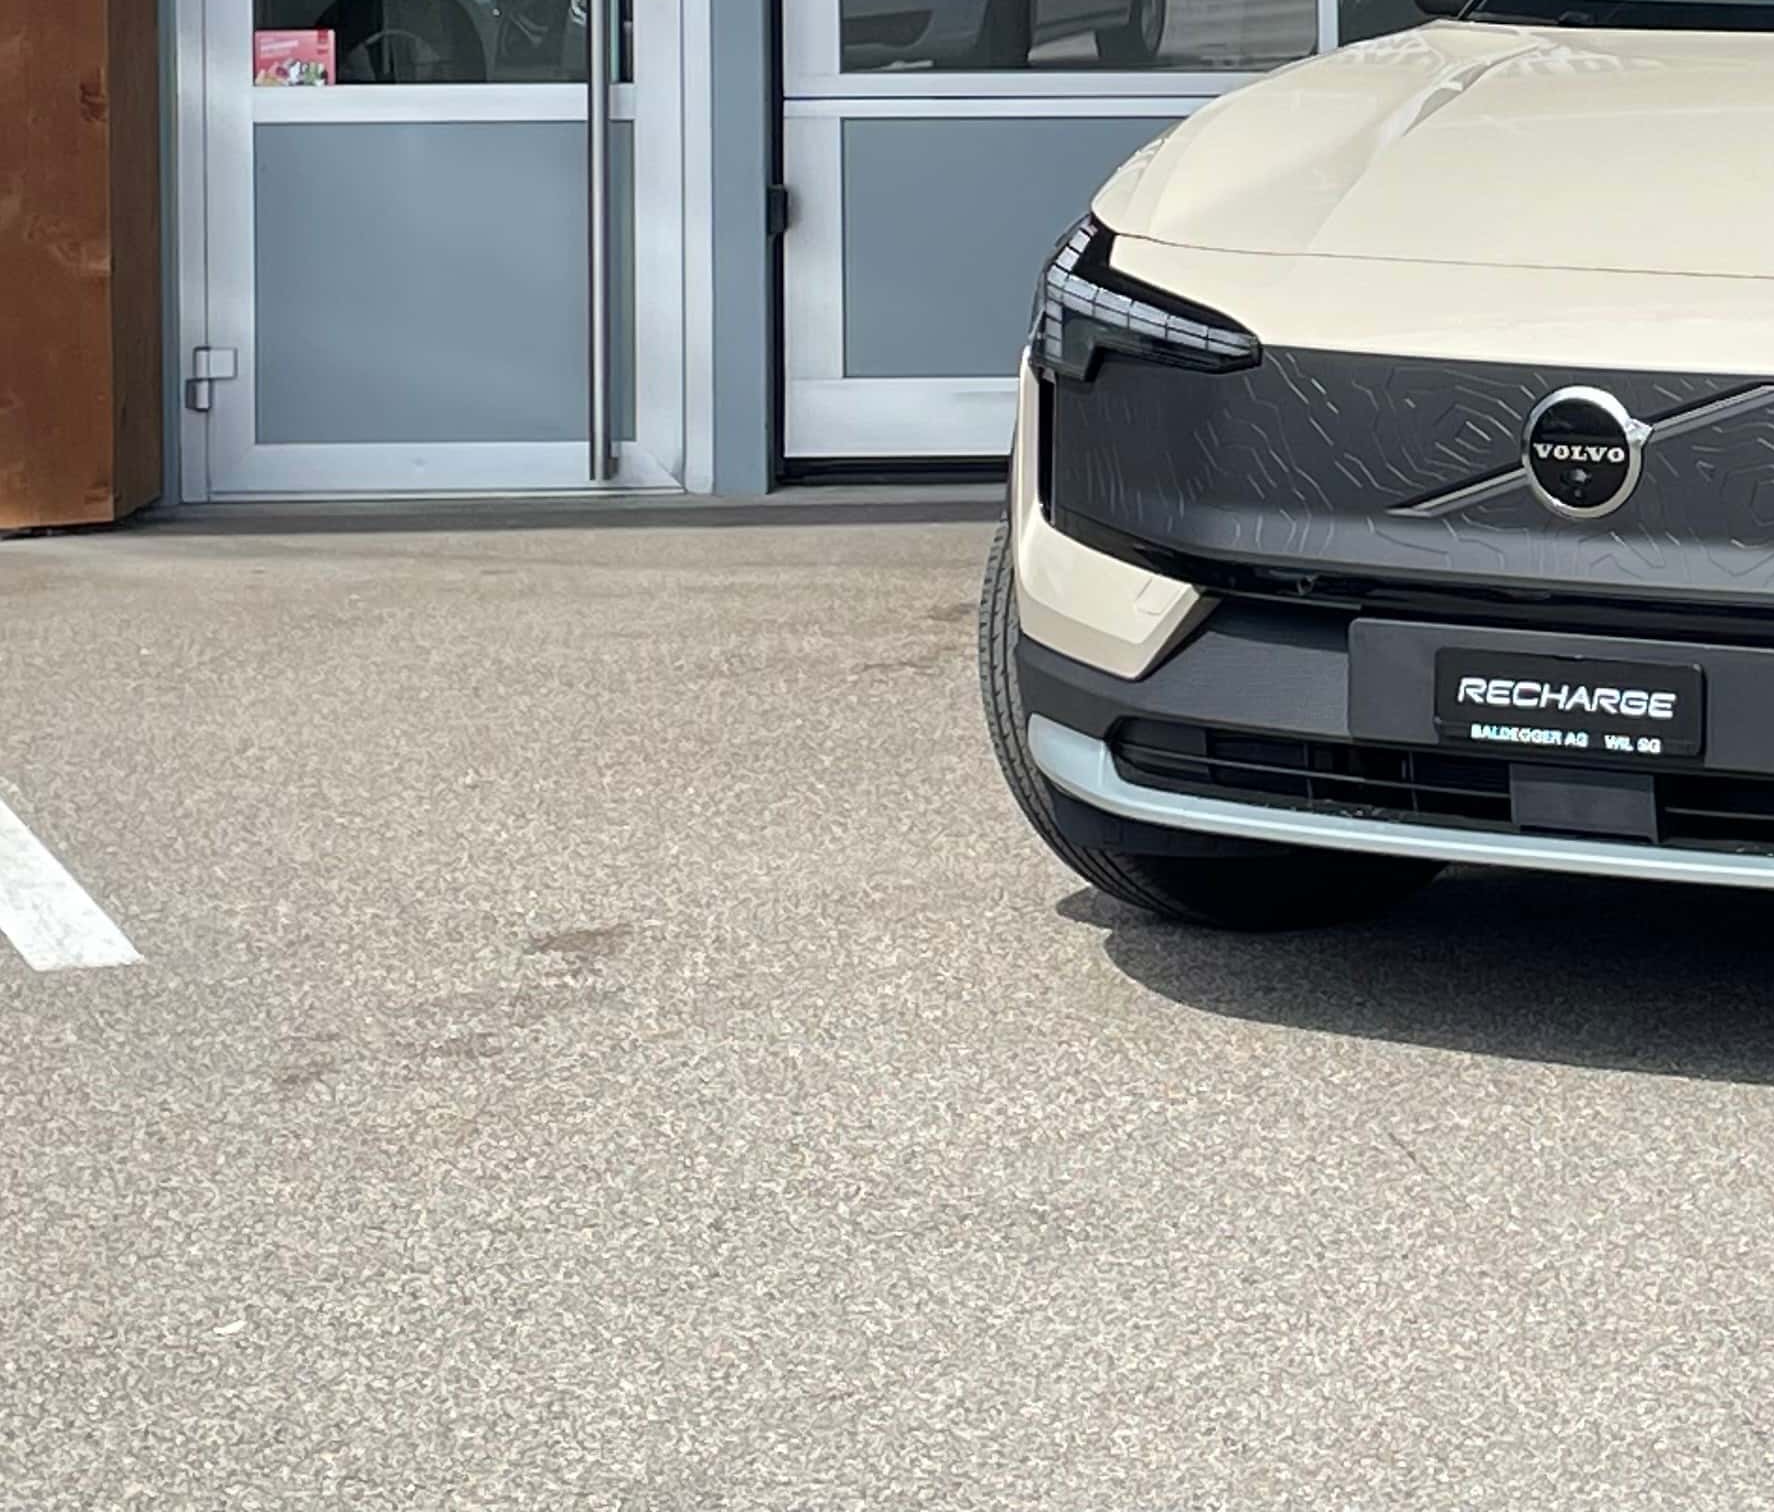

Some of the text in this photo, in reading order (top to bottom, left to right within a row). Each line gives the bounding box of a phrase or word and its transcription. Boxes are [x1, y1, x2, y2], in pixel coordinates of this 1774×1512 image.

[1533, 442, 1625, 464] VOLVO
[1457, 676, 1677, 719] RECHARGE
[1470, 724, 1563, 747] BALDEGGER
[1564, 731, 1589, 748] AG
